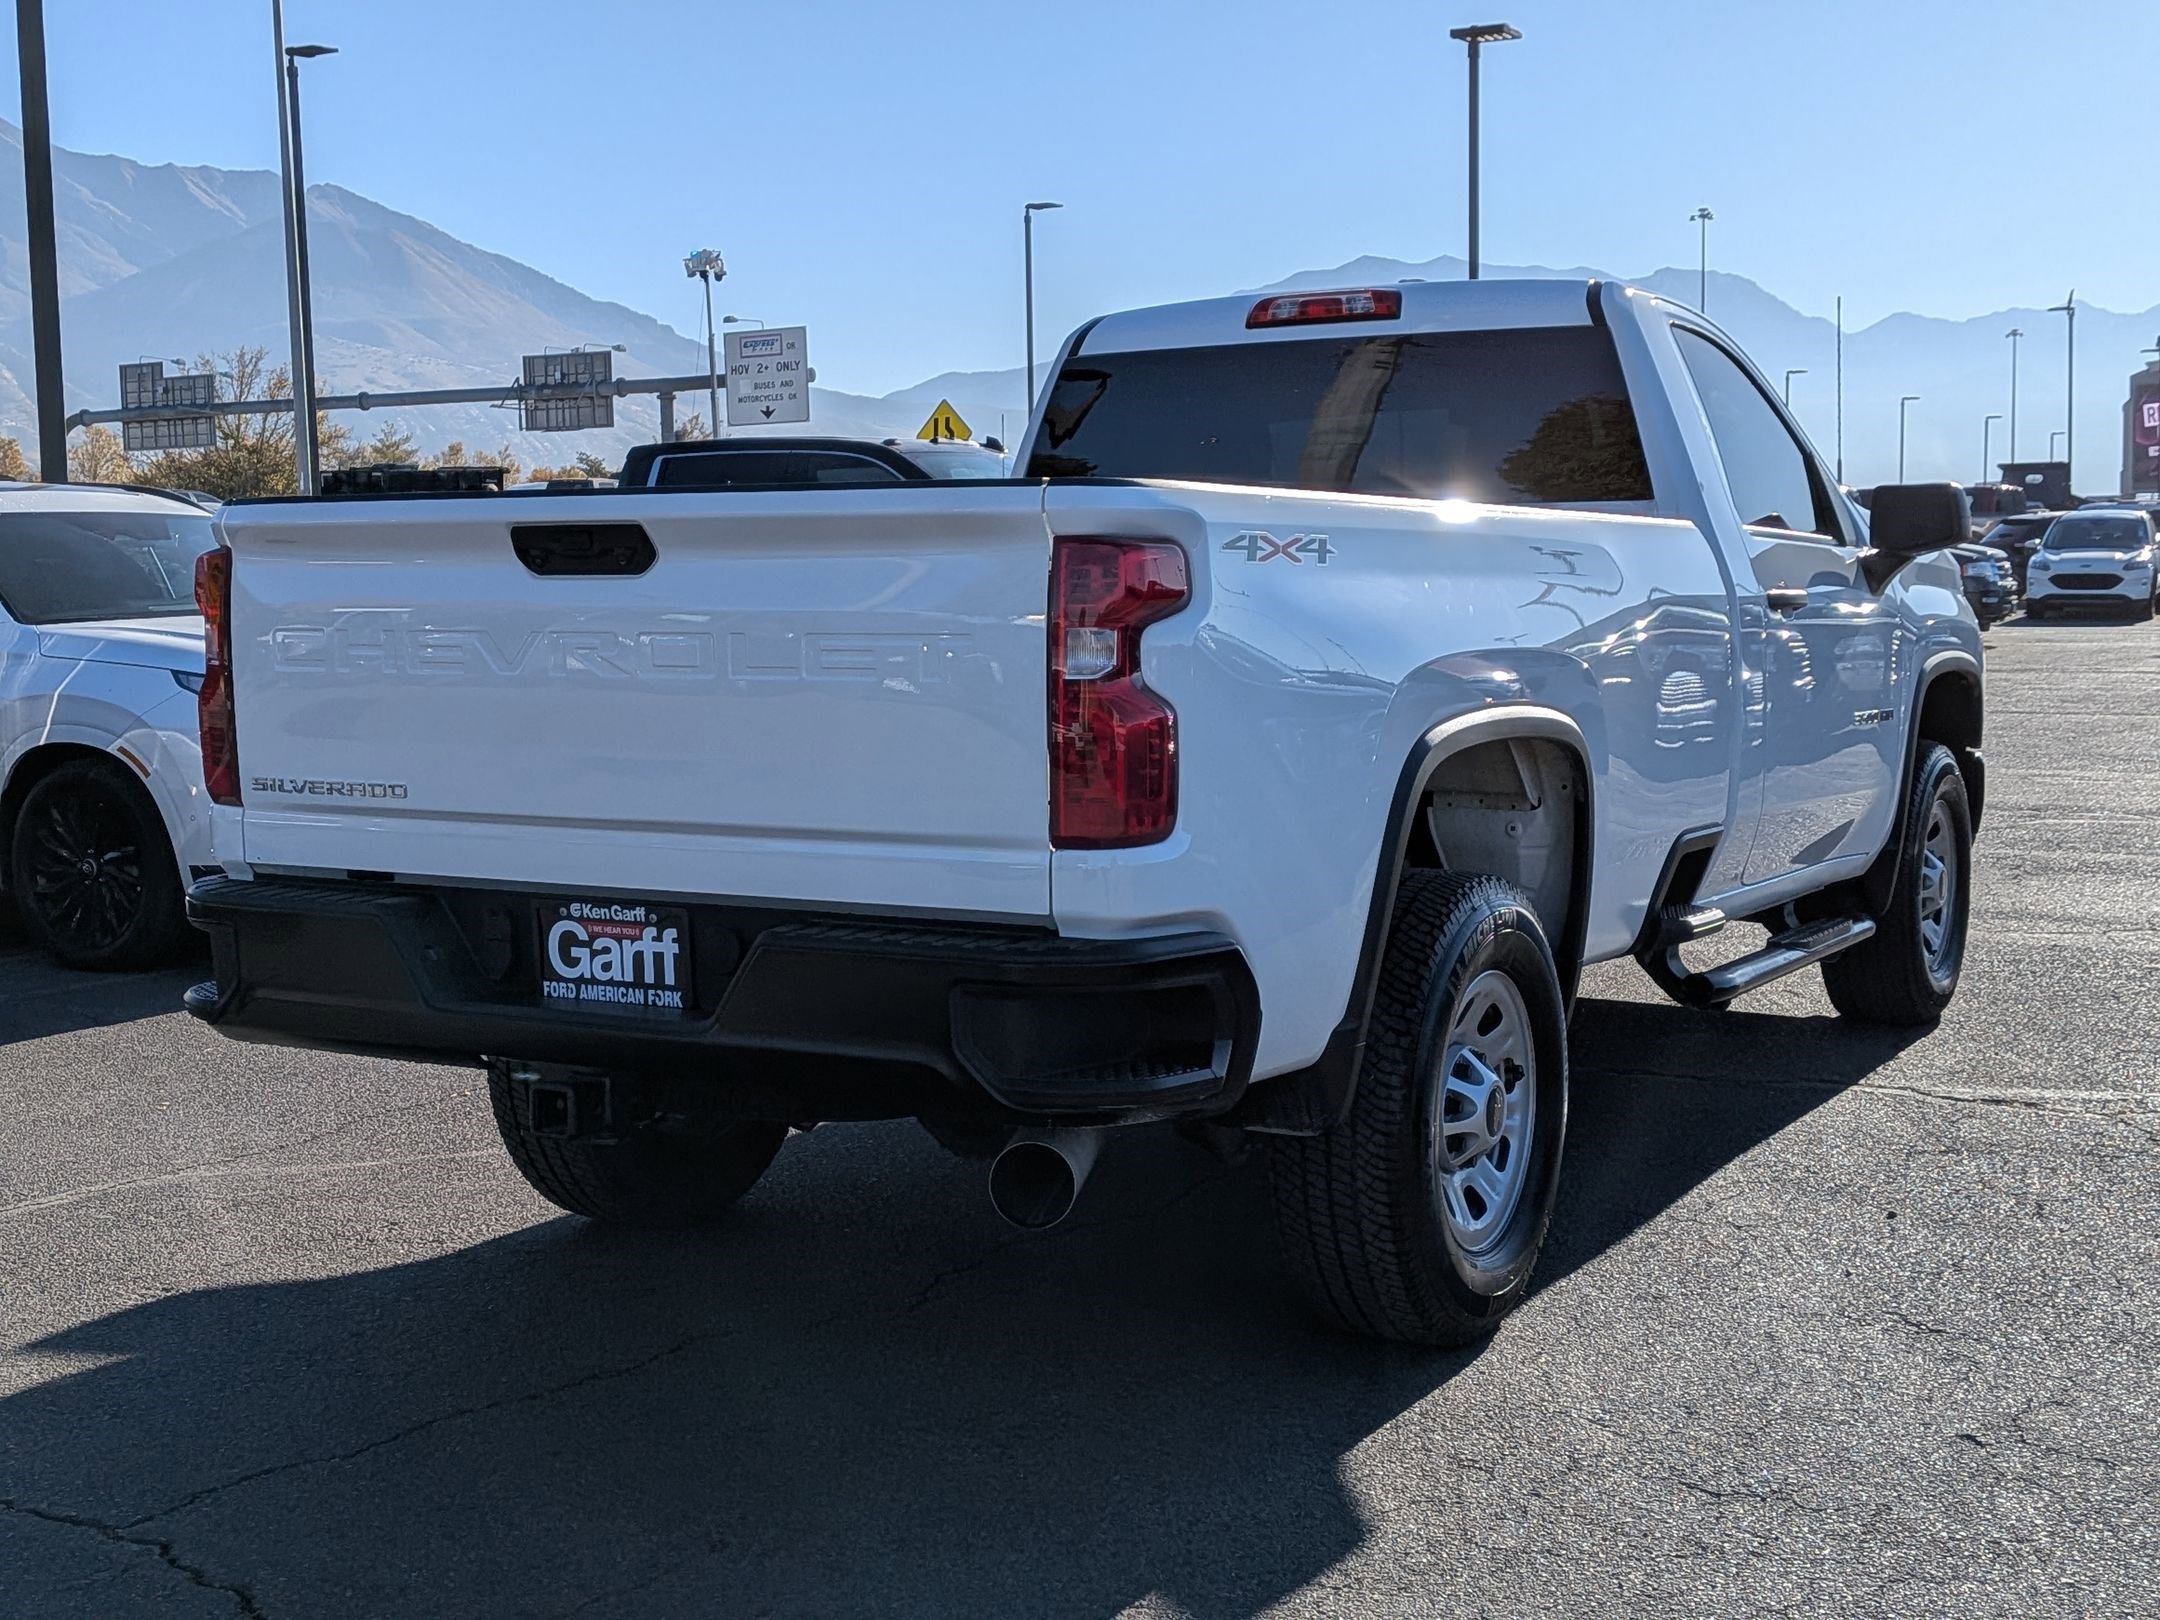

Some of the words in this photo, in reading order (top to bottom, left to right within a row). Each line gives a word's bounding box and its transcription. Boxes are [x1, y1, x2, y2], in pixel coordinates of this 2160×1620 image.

[730, 364, 750, 375] HOV
[757, 363, 769, 374] 2+
[776, 360, 801, 372] ONLY
[753, 382, 776, 390] BUSES
[780, 379, 794, 388] AND
[738, 393, 784, 404] MOTORCYCLES
[270, 625, 972, 682] CHEVROLET
[251, 776, 408, 799] SILVERADO
[593, 925, 603, 933] WE
[622, 927, 635, 935] YOU
[548, 920, 679, 985] Garff
[543, 981, 576, 999] FORD
[579, 984, 644, 1005] AMERICAN
[648, 990, 683, 1008] FORK
